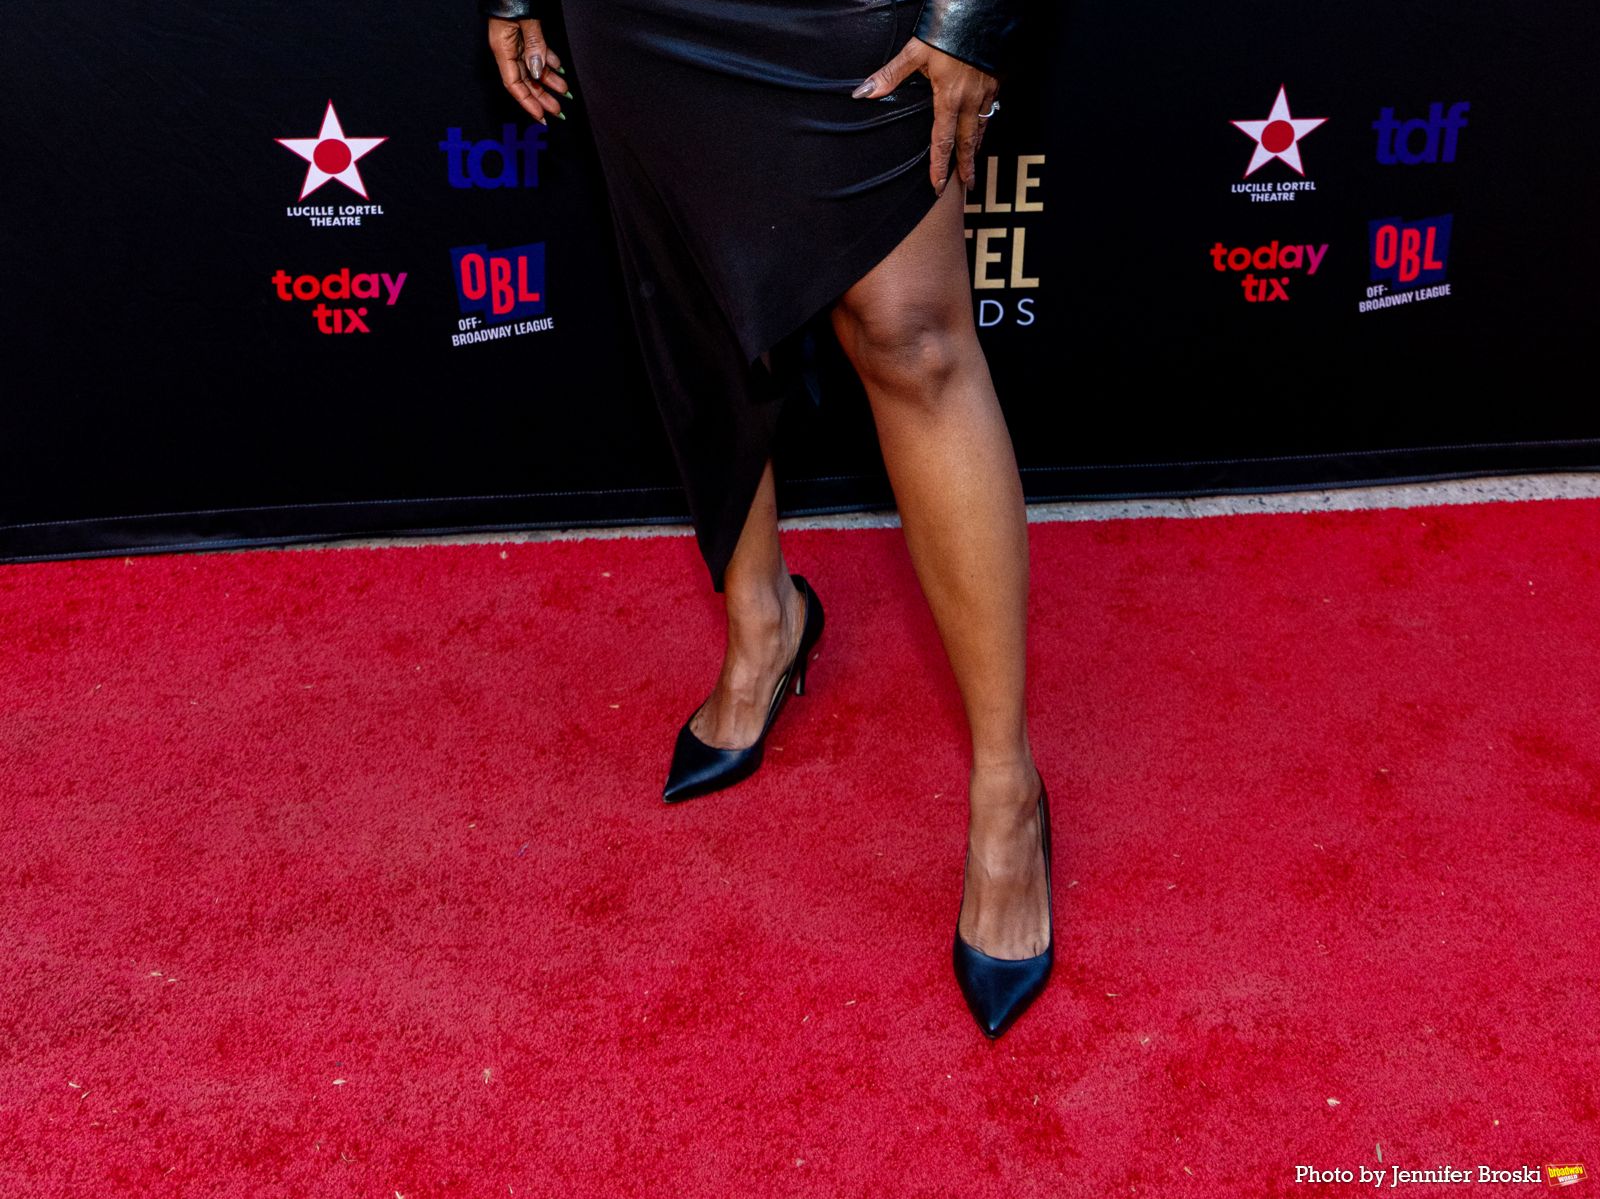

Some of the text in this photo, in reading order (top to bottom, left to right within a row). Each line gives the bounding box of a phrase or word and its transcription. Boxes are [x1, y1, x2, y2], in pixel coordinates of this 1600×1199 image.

[1371, 101, 1471, 165] tdf
[438, 123, 548, 190] tdf
[1231, 181, 1316, 193] LUCILLE LORTEL
[1250, 192, 1295, 202] THEATRE
[286, 205, 384, 217] LUCILLE LORTEL
[310, 216, 361, 227] THEATRE
[1210, 240, 1329, 275] today
[1375, 224, 1443, 282] OBL
[271, 268, 408, 306] today
[460, 253, 540, 316] OBL
[1241, 273, 1290, 303] tix
[1358, 283, 1451, 313] BROADWAY LEAGUE
[1366, 284, 1388, 298] OFF-
[312, 303, 371, 335] tix
[451, 317, 554, 347] BROADWAY LEAGUE
[458, 317, 482, 332] OFF-
